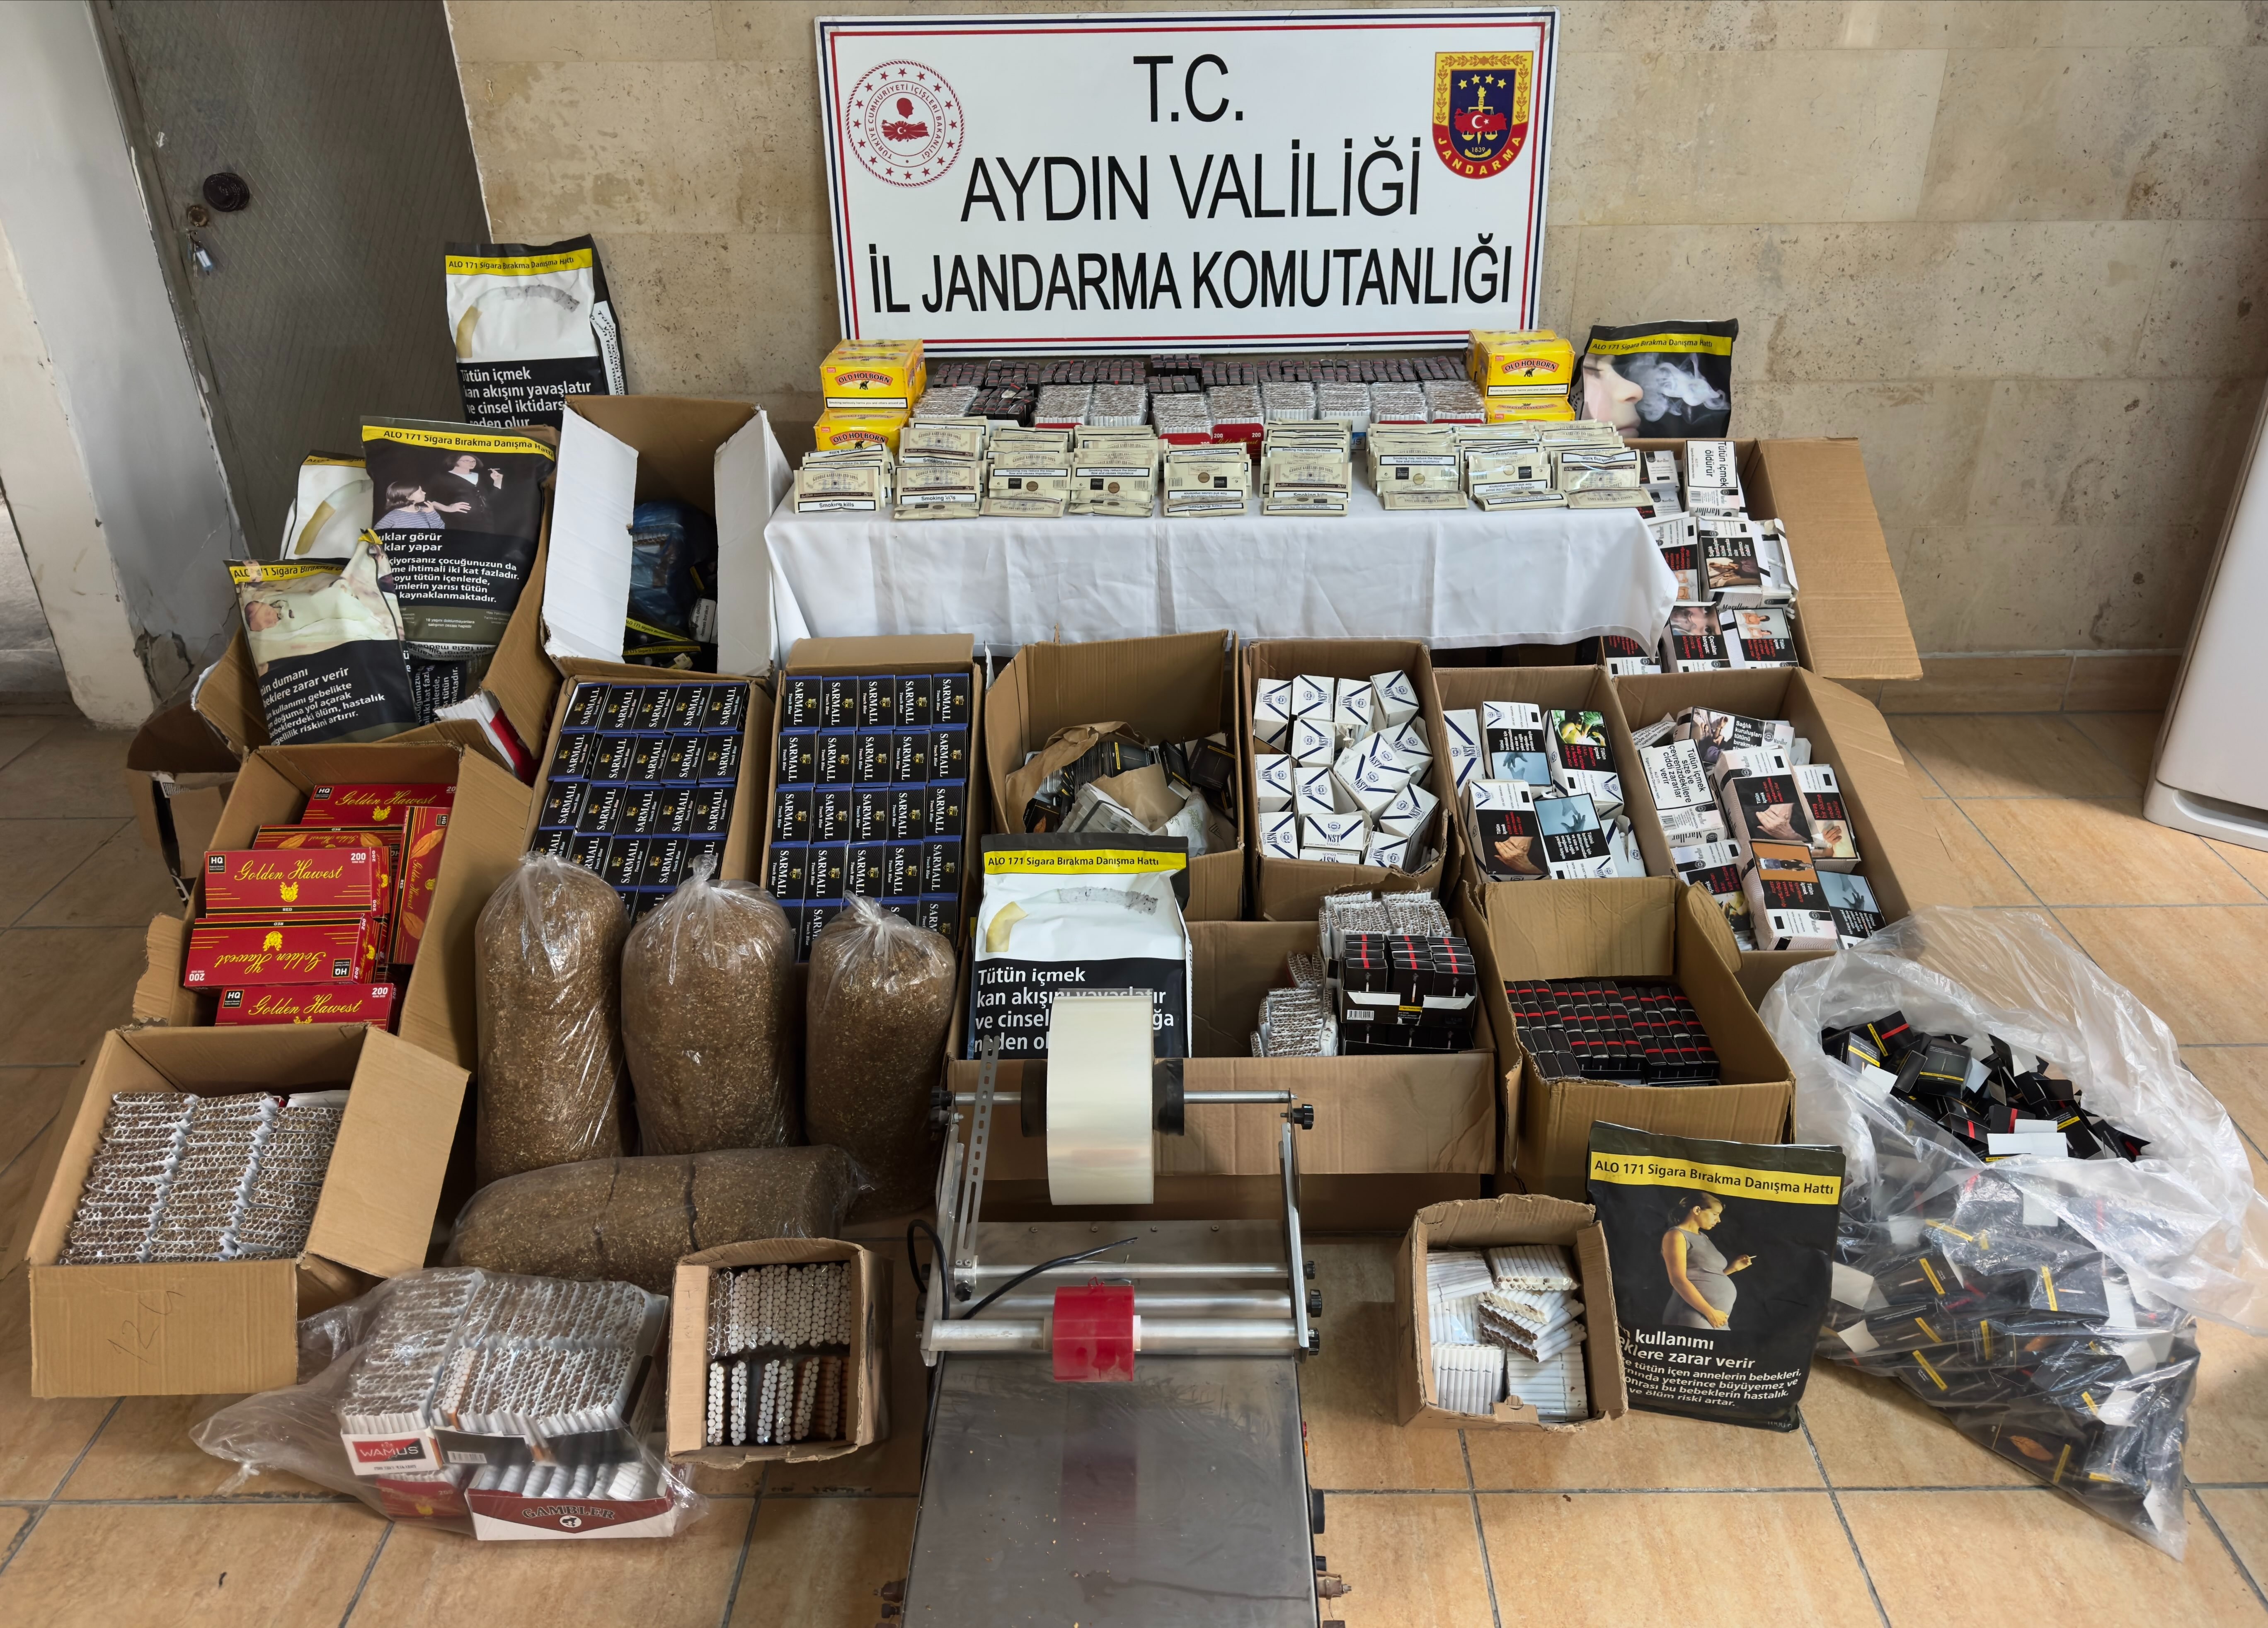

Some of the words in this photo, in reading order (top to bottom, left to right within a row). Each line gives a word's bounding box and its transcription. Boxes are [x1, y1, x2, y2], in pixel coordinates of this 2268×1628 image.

[1133, 54, 1244, 123] T.C.
[868, 83, 908, 123] CUMHURİYETİ
[912, 84, 938, 113] İÇİŞLERİ
[869, 128, 892, 159] TÜRKİYE
[922, 116, 943, 159] BAKANLIĞI
[1438, 137, 1521, 174] JANDARMA
[961, 155, 1148, 222] AYDIN
[1170, 136, 1422, 219] VALİLİĞİ
[480, 261, 502, 270] Sigara
[531, 259, 557, 269] Danışma
[869, 244, 909, 313] İL
[922, 251, 1181, 313] JANDARMA
[1194, 233, 1512, 310] KOMUTANLIĞI
[1669, 339, 1697, 348] Danışma
[493, 366, 531, 384] içmek
[1505, 362, 1519, 371] OLD
[1522, 360, 1556, 370] HOLBORN
[838, 374, 853, 383] OLD
[854, 373, 890, 383] HOLBORN
[463, 385, 480, 398] kan
[483, 385, 523, 400] akışını
[527, 381, 591, 399] yavaşlatır
[478, 400, 512, 414] cinsel
[424, 435, 452, 445] Sigara
[456, 438, 492, 447] Bırakma
[494, 440, 532, 450] Danışma
[1718, 441, 1727, 462] Tütün
[1705, 450, 1715, 477] öldürür
[1717, 464, 1729, 486] içmek
[410, 533, 442, 541] görür
[408, 544, 442, 552] yapar
[439, 559, 503, 569] çocuğunuzun
[443, 575, 490, 585] içenlerde,
[481, 568, 519, 580] fazladır.
[400, 591, 497, 602] kaynaklanmaktadır.
[461, 585, 487, 593] tütün
[272, 669, 308, 689] dumanı
[293, 677, 319, 693] zarar
[322, 667, 349, 682] verir
[272, 698, 306, 717] kullanımı
[308, 683, 352, 702] gebelikte
[274, 708, 304, 725] doğuma
[305, 703, 318, 714] yol
[320, 692, 351, 706] açarak
[315, 706, 341, 718] ölüm,
[343, 693, 385, 709] hastalık
[684, 688, 702, 726] SARMALL
[794, 682, 804, 725] SARMALL
[300, 719, 327, 733] riskini
[329, 710, 359, 723] artırır.
[1736, 721, 1752, 729] Sağlık
[1734, 733, 1750, 742] tütünü
[1735, 727, 1762, 738] kuruluşları
[1660, 768, 1670, 784] verir
[1663, 752, 1672, 769] ciddi
[1669, 770, 1682, 798] zararlar
[1667, 745, 1691, 803] çevrenizdekilere
[1682, 760, 1691, 774] size
[1688, 775, 1694, 784] ve
[1687, 748, 1698, 772] Tütün
[1693, 771, 1706, 792] içmek
[1327, 834, 1340, 842] NST
[351, 852, 366, 861] 200
[988, 857, 1006, 866] ALO
[1026, 856, 1054, 868] Sigara
[1058, 856, 1093, 866] Bırakma
[1096, 856, 1134, 867] Danışma
[1137, 857, 1159, 865] Hattı
[234, 860, 285, 881] Golden
[978, 967, 1026, 985] Tütün
[1032, 967, 1086, 985] içmek
[248, 995, 300, 1016] Golden
[976, 990, 1006, 1008] kan
[975, 1015, 993, 1030] ve
[998, 1009, 1050, 1028] cinsel
[1595, 1161, 1619, 1173] ALO
[1623, 1164, 1643, 1174] 171
[1648, 1164, 1686, 1178] Sigara
[1690, 1168, 1740, 1186] Bırakma
[1745, 1177, 1800, 1194] Danışma
[1804, 1183, 1833, 1195] Hattı
[1636, 1329, 1714, 1350] kullanımı
[1668, 1353, 1711, 1366] zarar
[1716, 1358, 1755, 1368] verir
[1635, 1362, 1665, 1374] tütün
[1668, 1367, 1690, 1376] içen
[1693, 1372, 1746, 1381] annelerin
[1749, 1369, 1801, 1381] bebekleri,
[1663, 1377, 1716, 1389] yeterince
[1719, 1382, 1783, 1391] büyüyemez
[1679, 1387, 1740, 1398] bebeklerin
[1744, 1390, 1788, 1399] hastalık,
[1645, 1390, 1674, 1399] ölüm
[359, 1447, 419, 1456] WAMUS
[522, 1505, 615, 1519] GAMBLER
